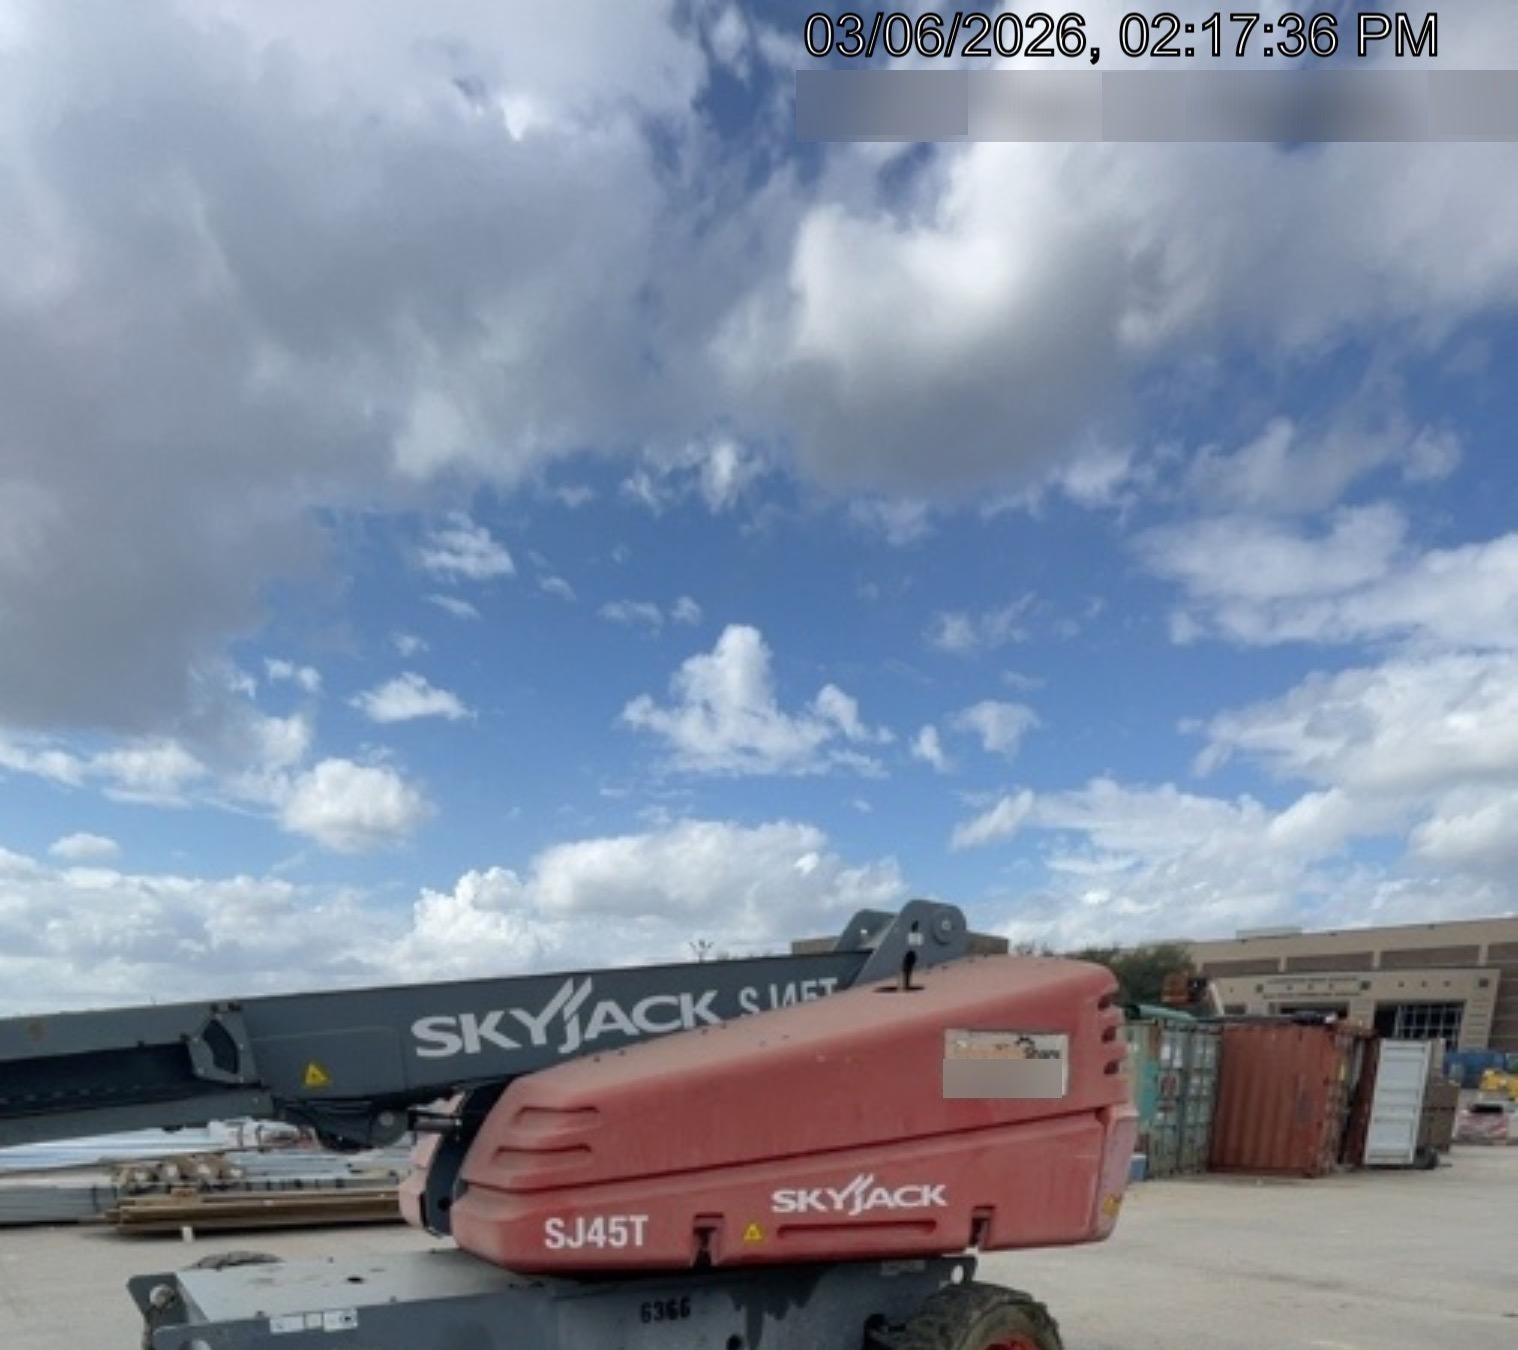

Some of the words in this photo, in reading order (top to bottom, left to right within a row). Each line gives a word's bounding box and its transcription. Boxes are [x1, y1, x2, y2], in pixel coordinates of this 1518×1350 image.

[412, 977, 719, 1057] SKYJACK
[771, 1174, 947, 1216] SKYJACK
[544, 1214, 649, 1250] SJ45T
